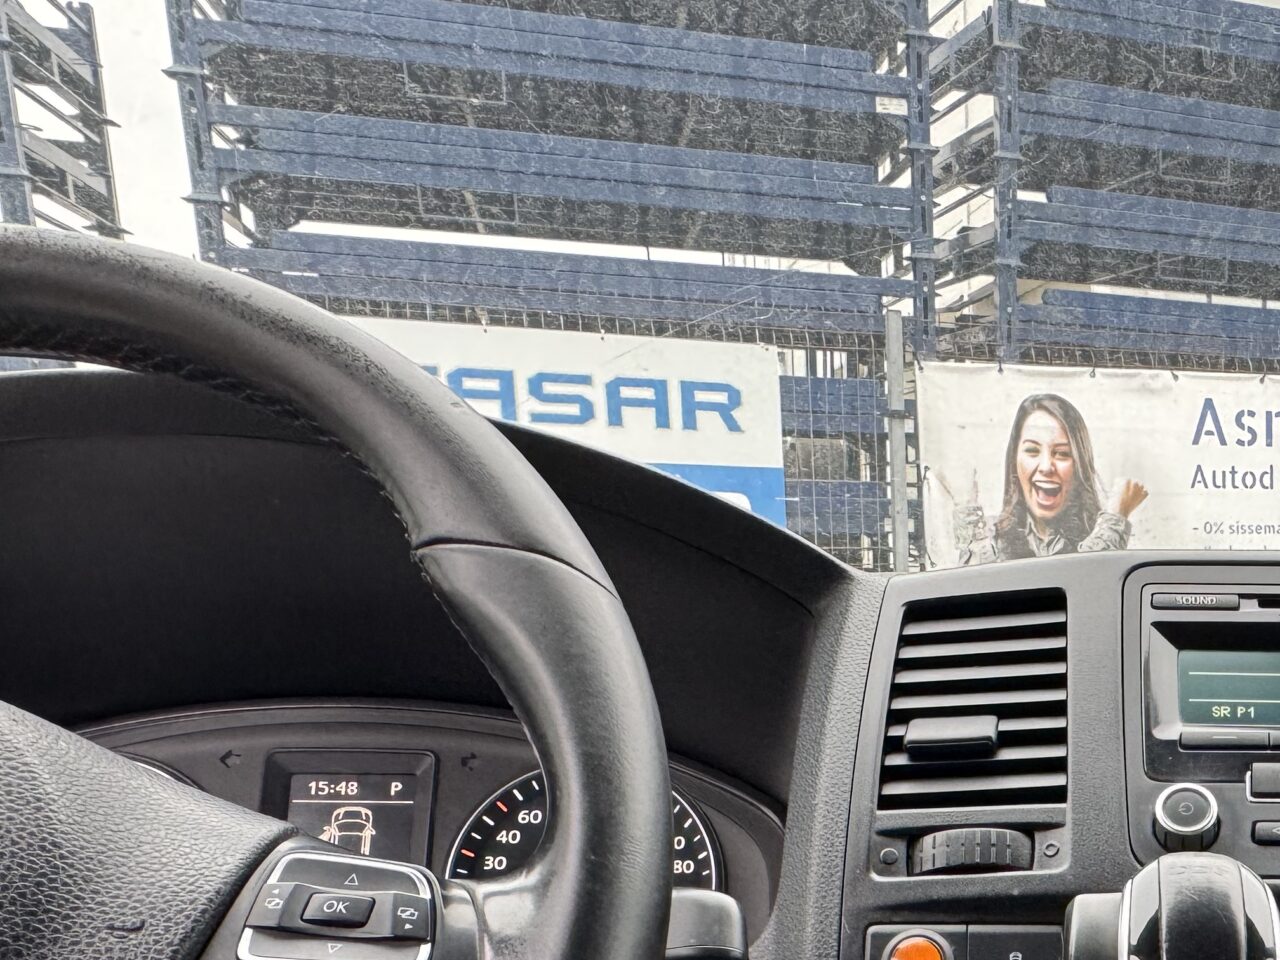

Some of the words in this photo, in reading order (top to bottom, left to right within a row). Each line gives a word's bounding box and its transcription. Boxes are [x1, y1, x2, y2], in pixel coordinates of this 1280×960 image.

[419, 365, 744, 433] ASAR
[1190, 464, 1275, 492] Autod
[1203, 521, 1225, 535] 0%
[1176, 595, 1217, 606] SOUND
[1211, 705, 1233, 718] SR
[1237, 706, 1255, 719] P1
[307, 781, 358, 796] 15:48
[390, 781, 402, 796] P
[517, 809, 543, 825] 60
[495, 829, 521, 845] 40
[483, 855, 508, 871] 30
[322, 899, 350, 916] OK
